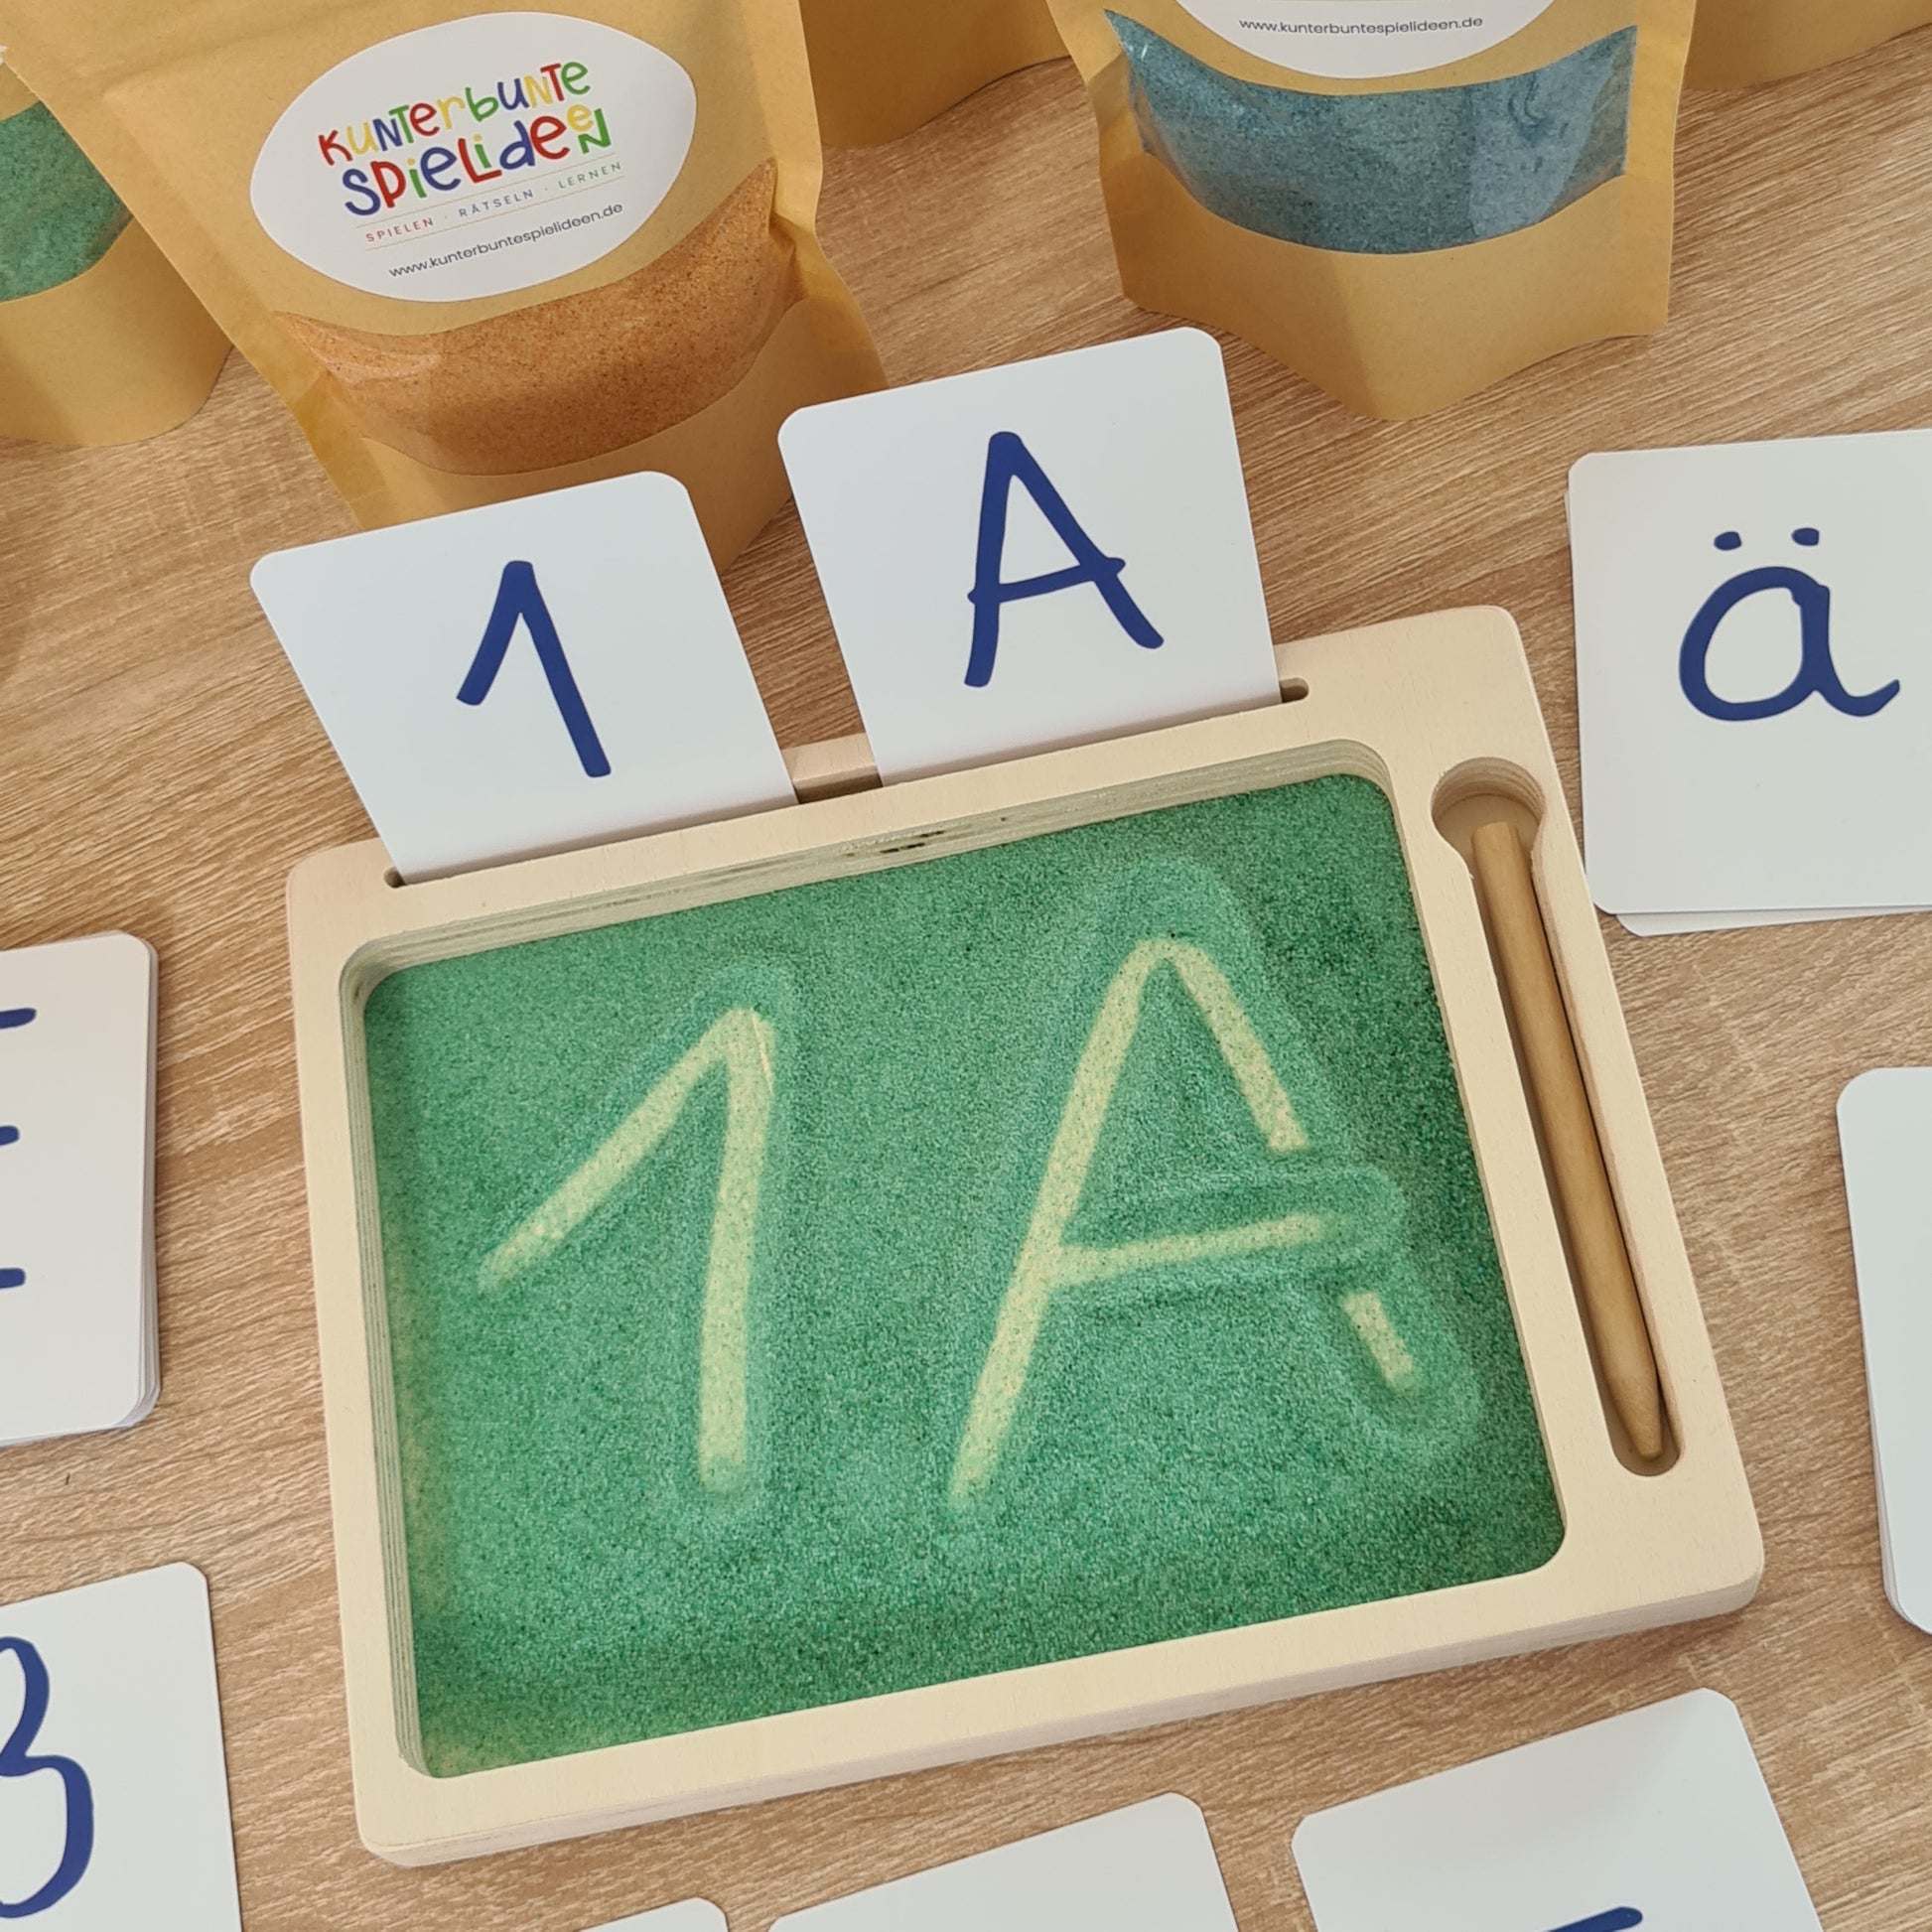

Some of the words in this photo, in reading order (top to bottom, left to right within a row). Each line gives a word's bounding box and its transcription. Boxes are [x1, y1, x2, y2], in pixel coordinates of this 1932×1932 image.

[1239, 16, 1483, 37] www.kunterbuntespielideen.de
[365, 217, 434, 242] SPIELEN
[459, 189, 533, 217] RÄTSELN
[558, 162, 621, 189] LERNEN
[389, 203, 623, 277] www.kunterbuntespielideen.de
[965, 431, 1163, 688] A
[1680, 527, 1900, 721] ä
[456, 561, 611, 777] 1
[478, 1006, 776, 1493] 1
[947, 937, 1416, 1509] A
